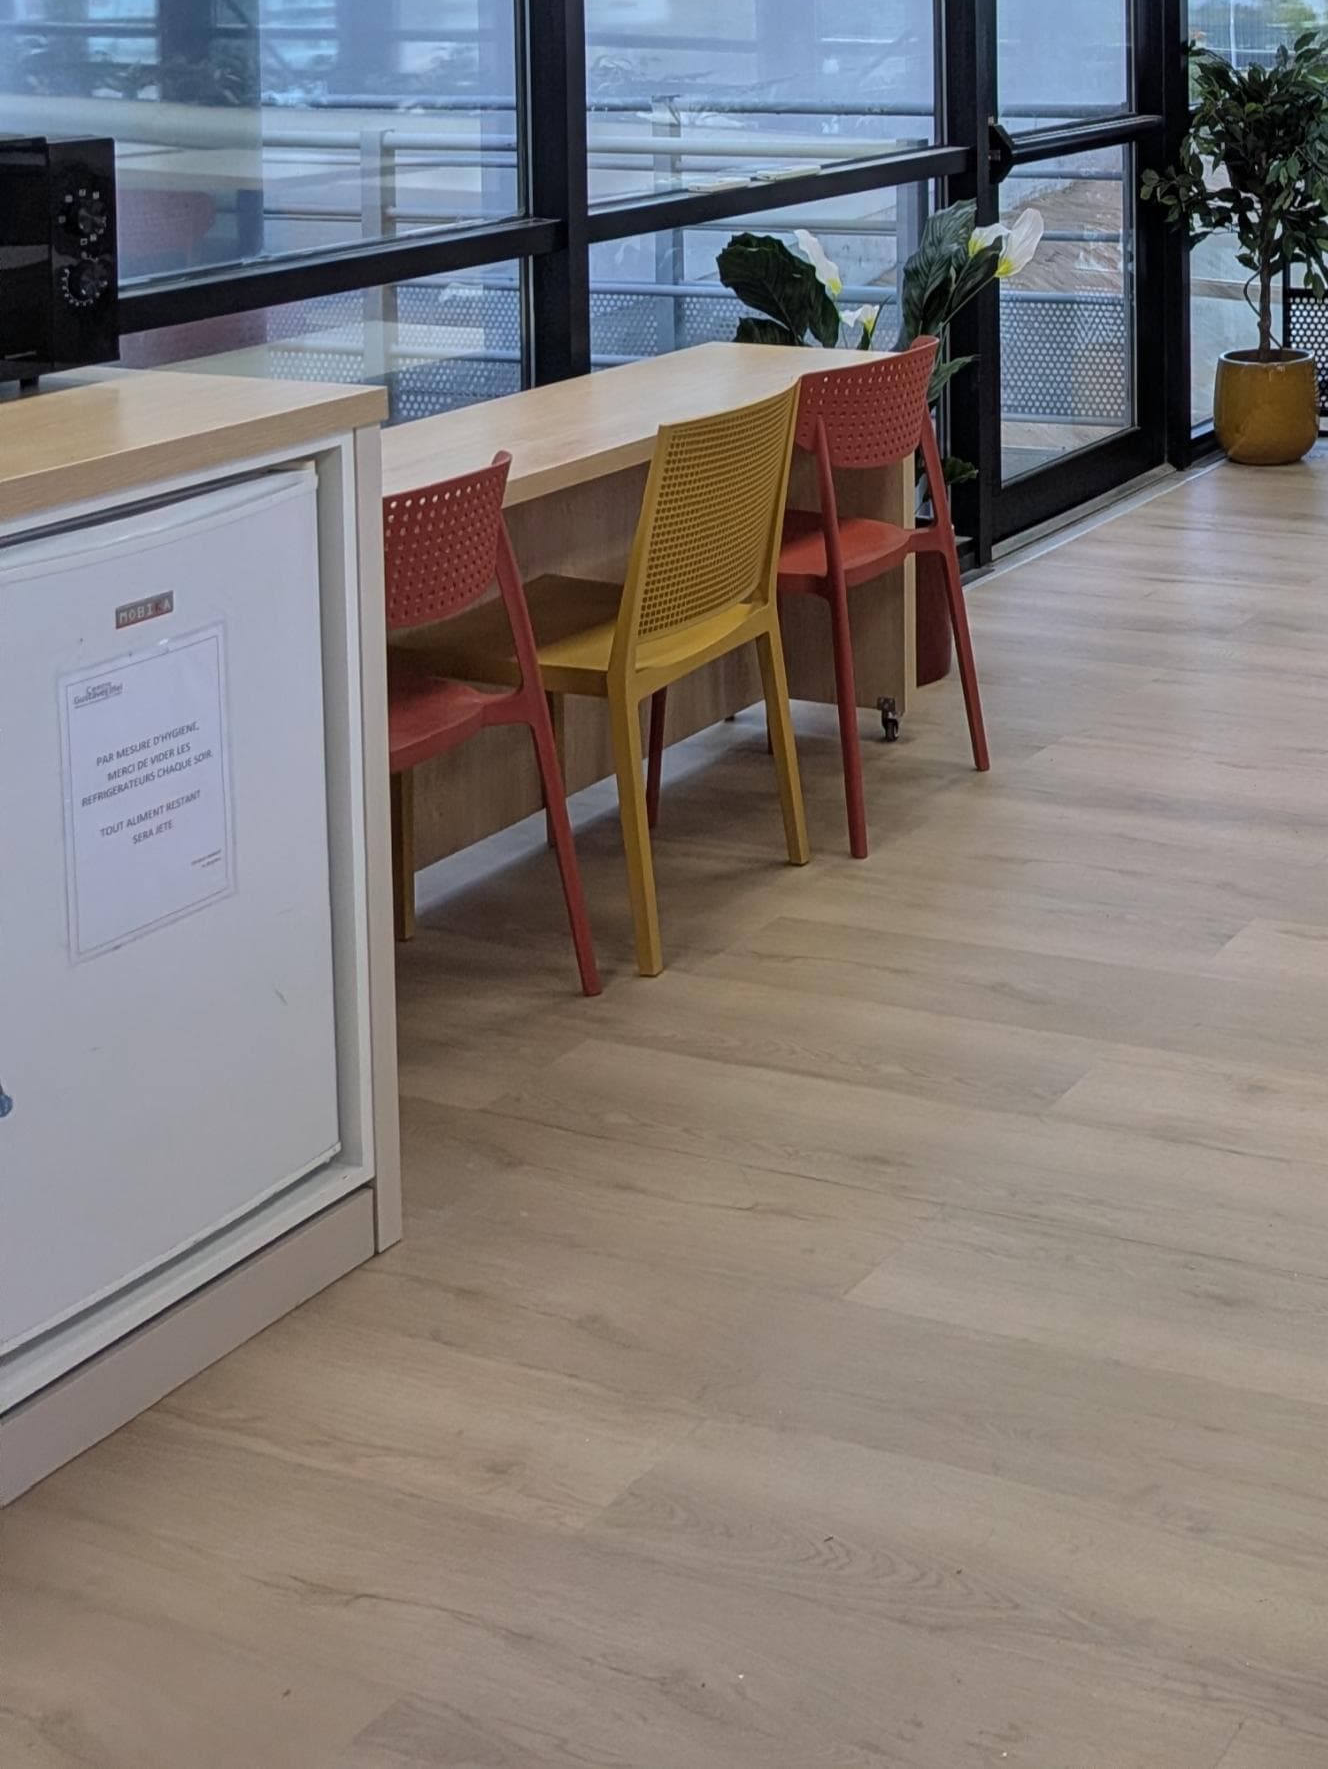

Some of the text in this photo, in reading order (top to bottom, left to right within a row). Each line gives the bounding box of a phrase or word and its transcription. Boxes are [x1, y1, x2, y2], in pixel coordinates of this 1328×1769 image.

[96, 752, 114, 767] PAR
[116, 738, 151, 760] MESURE
[107, 741, 192, 781] MERCI DE VIDER LES
[156, 757, 193, 779] CHAQUE
[99, 789, 201, 837] TOUT ALIMENT RESTANT
[132, 828, 154, 845] SERA
